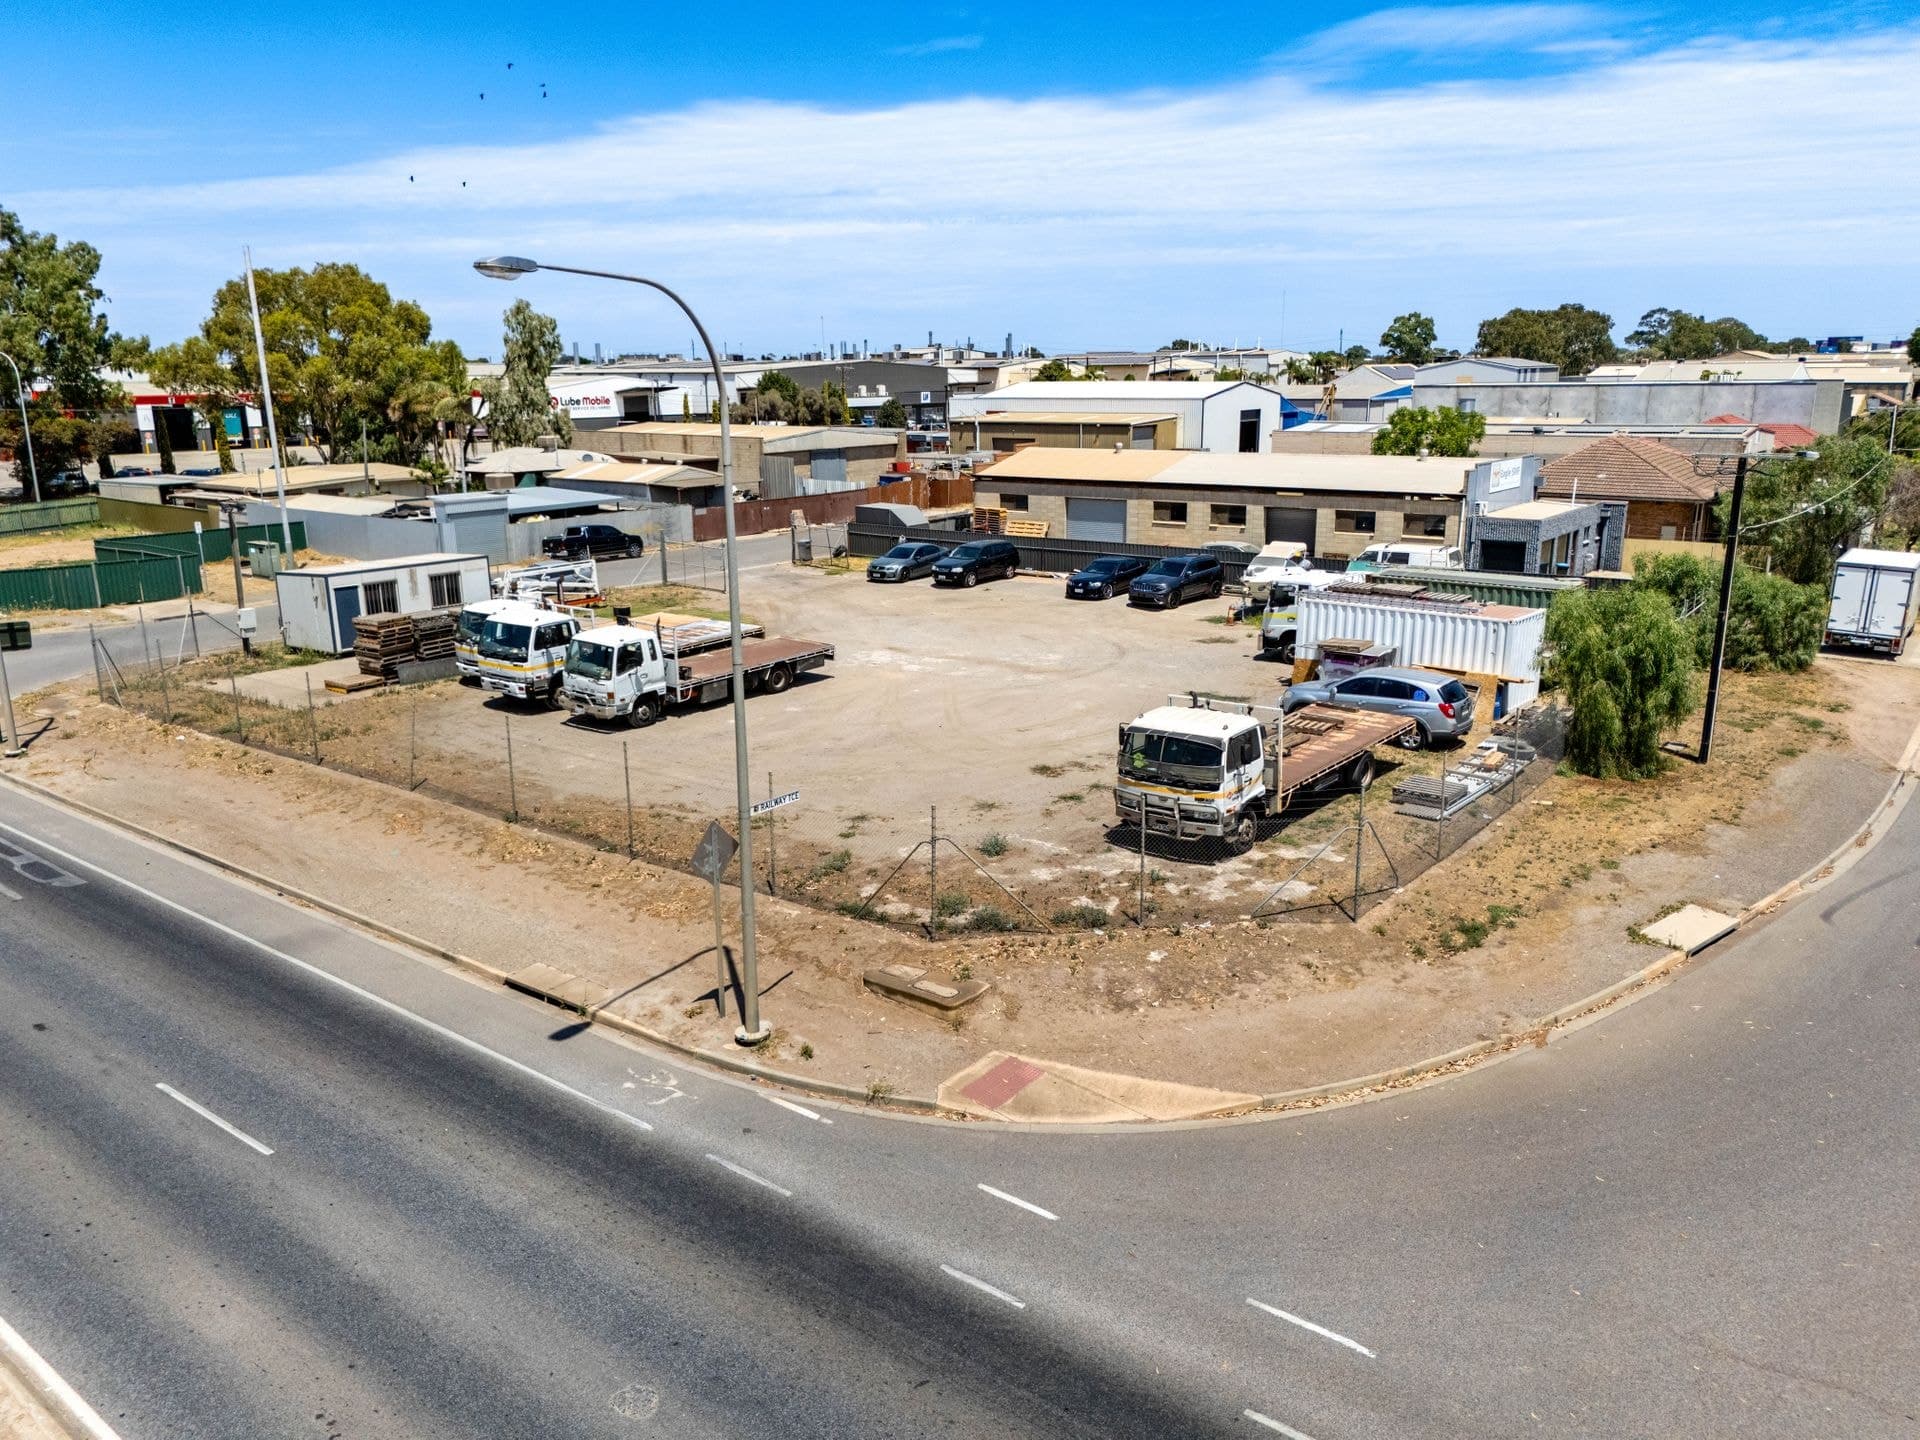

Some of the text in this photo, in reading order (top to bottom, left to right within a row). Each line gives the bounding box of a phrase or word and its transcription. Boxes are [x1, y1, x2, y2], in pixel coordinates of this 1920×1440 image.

[560, 396, 610, 406] Lube Mobile
[760, 791, 799, 811] RAILWAY TCE
